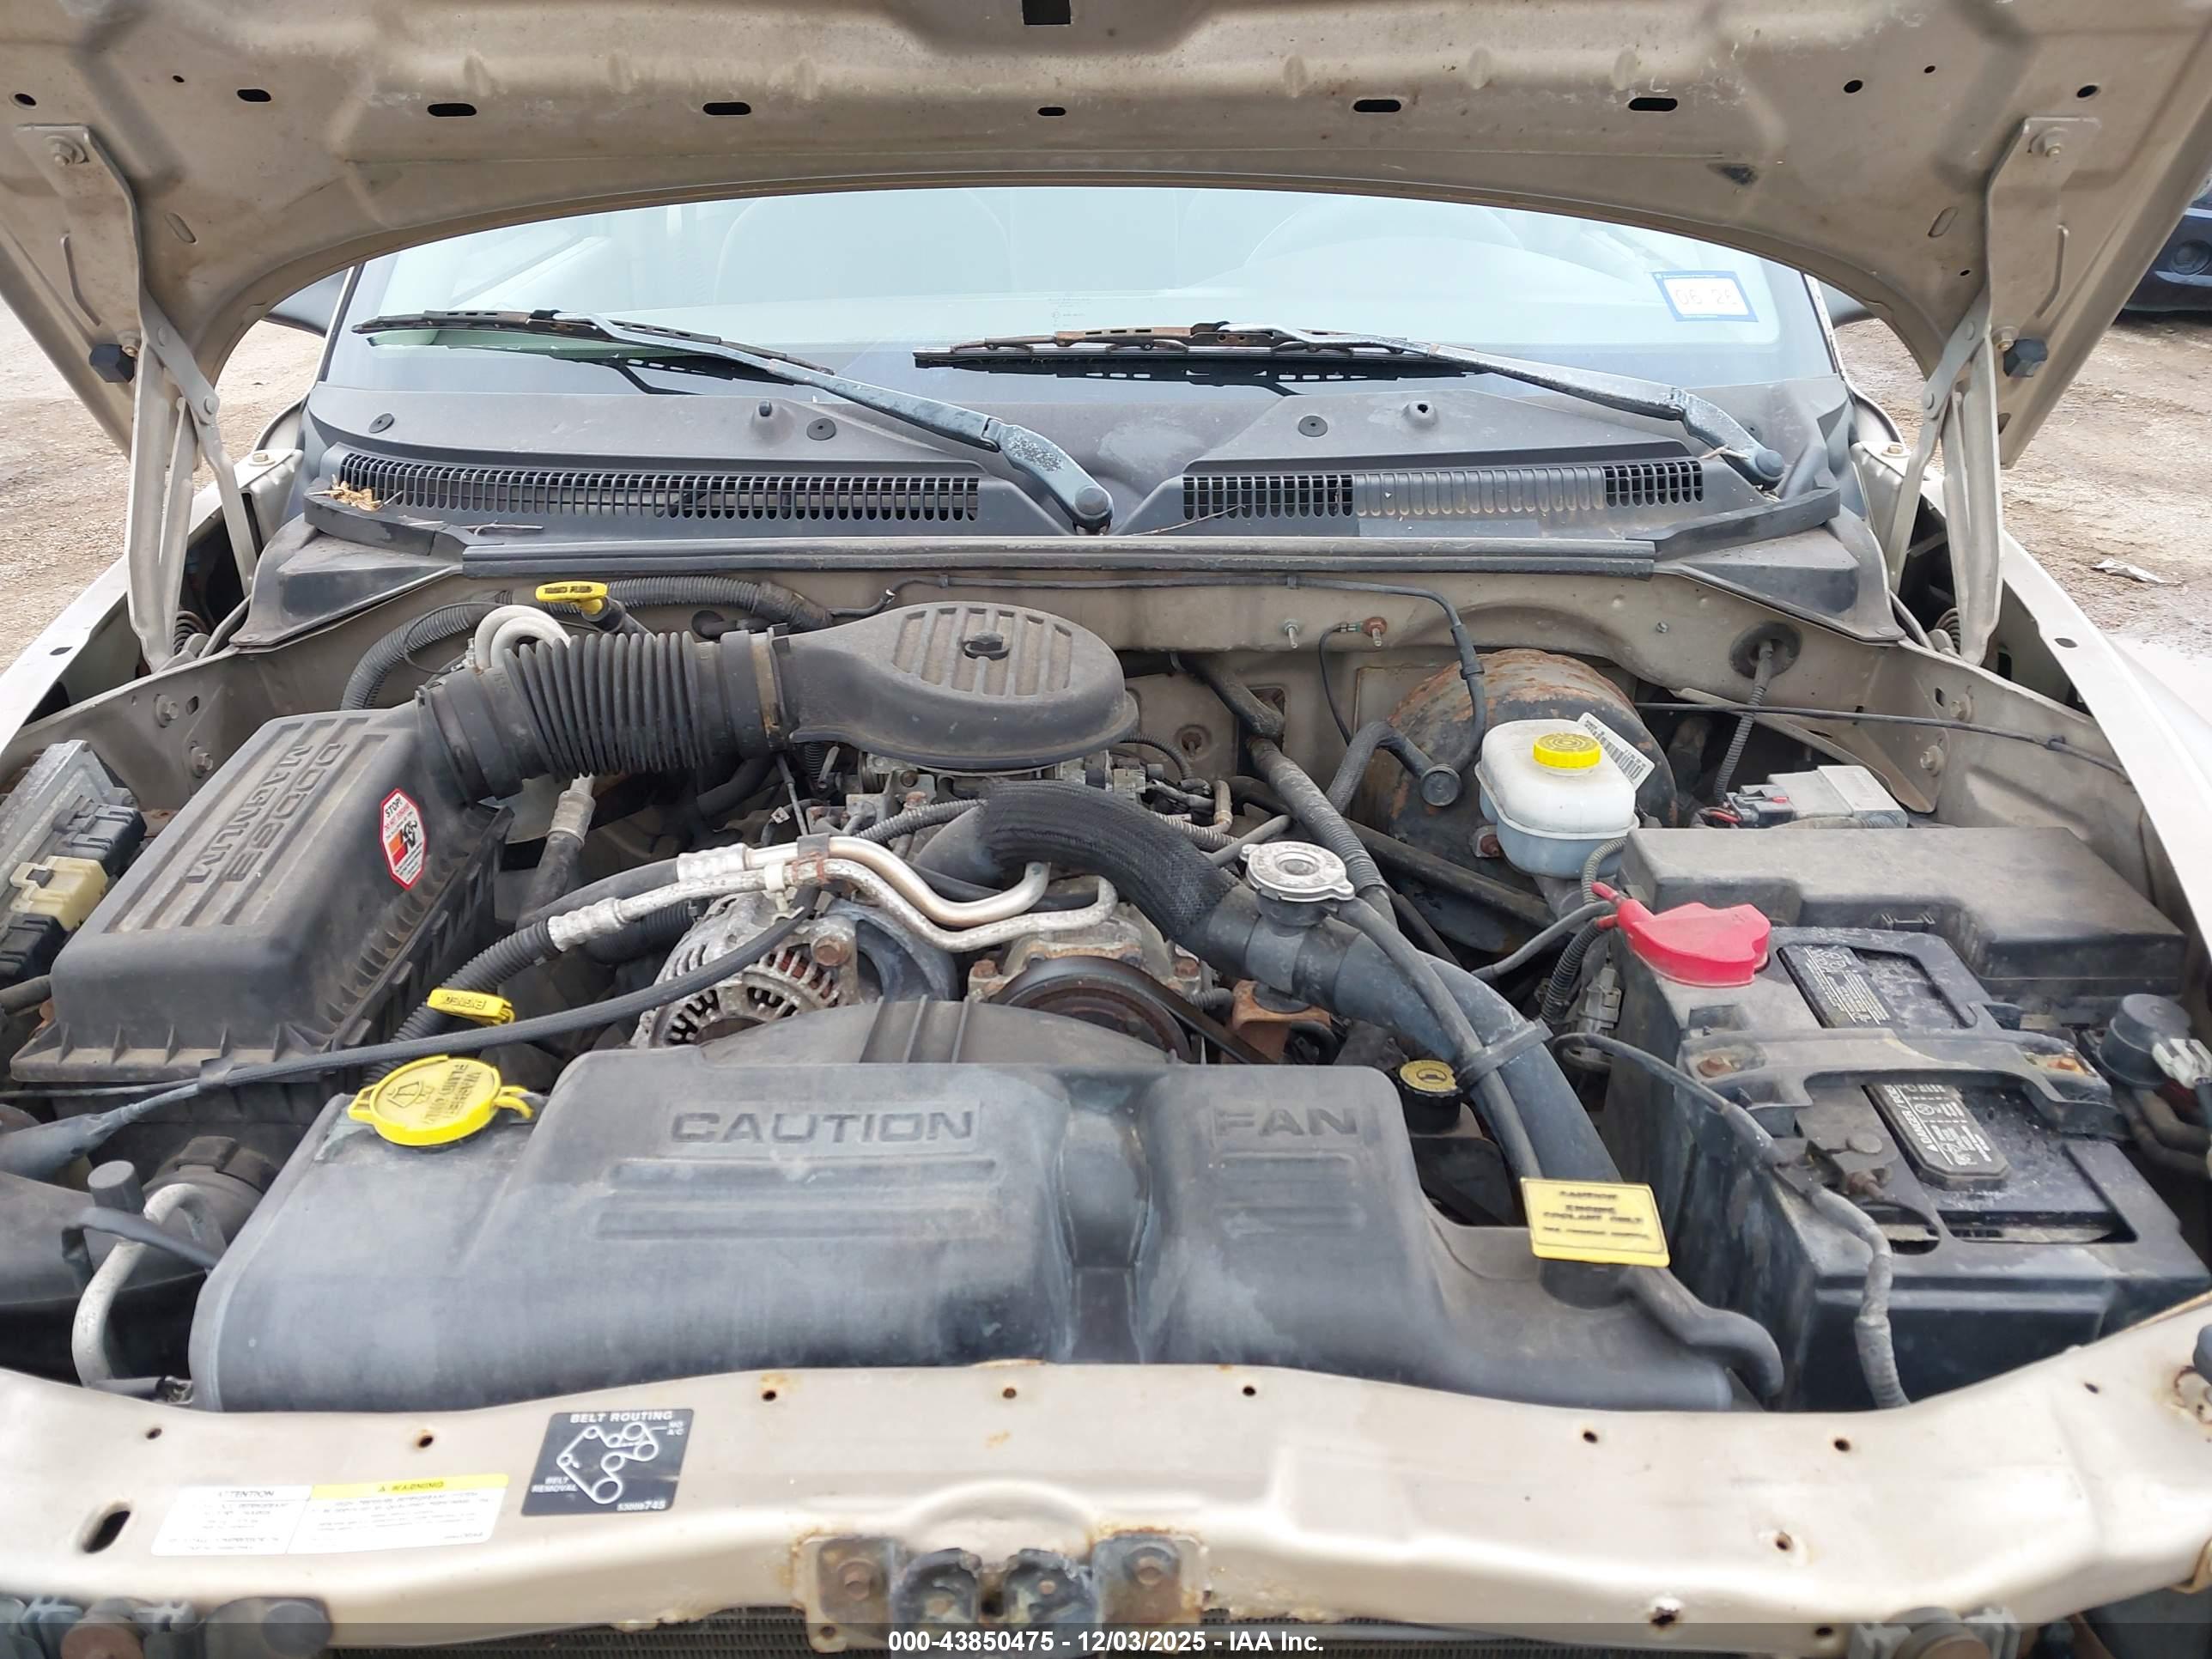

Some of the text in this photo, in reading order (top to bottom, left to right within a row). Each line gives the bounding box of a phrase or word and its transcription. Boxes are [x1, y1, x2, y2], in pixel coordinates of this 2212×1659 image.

[185, 744, 314, 883] MAGNUM
[223, 742, 346, 882] DODGE
[671, 1110, 974, 1143] CAUTION
[1213, 1108, 1358, 1137] FAN
[1901, 1109, 1933, 1144] DANGER
[569, 1410, 673, 1424] BELT ROUTING
[531, 1484, 578, 1493] REMOVAL
[545, 1476, 570, 1485] BELT
